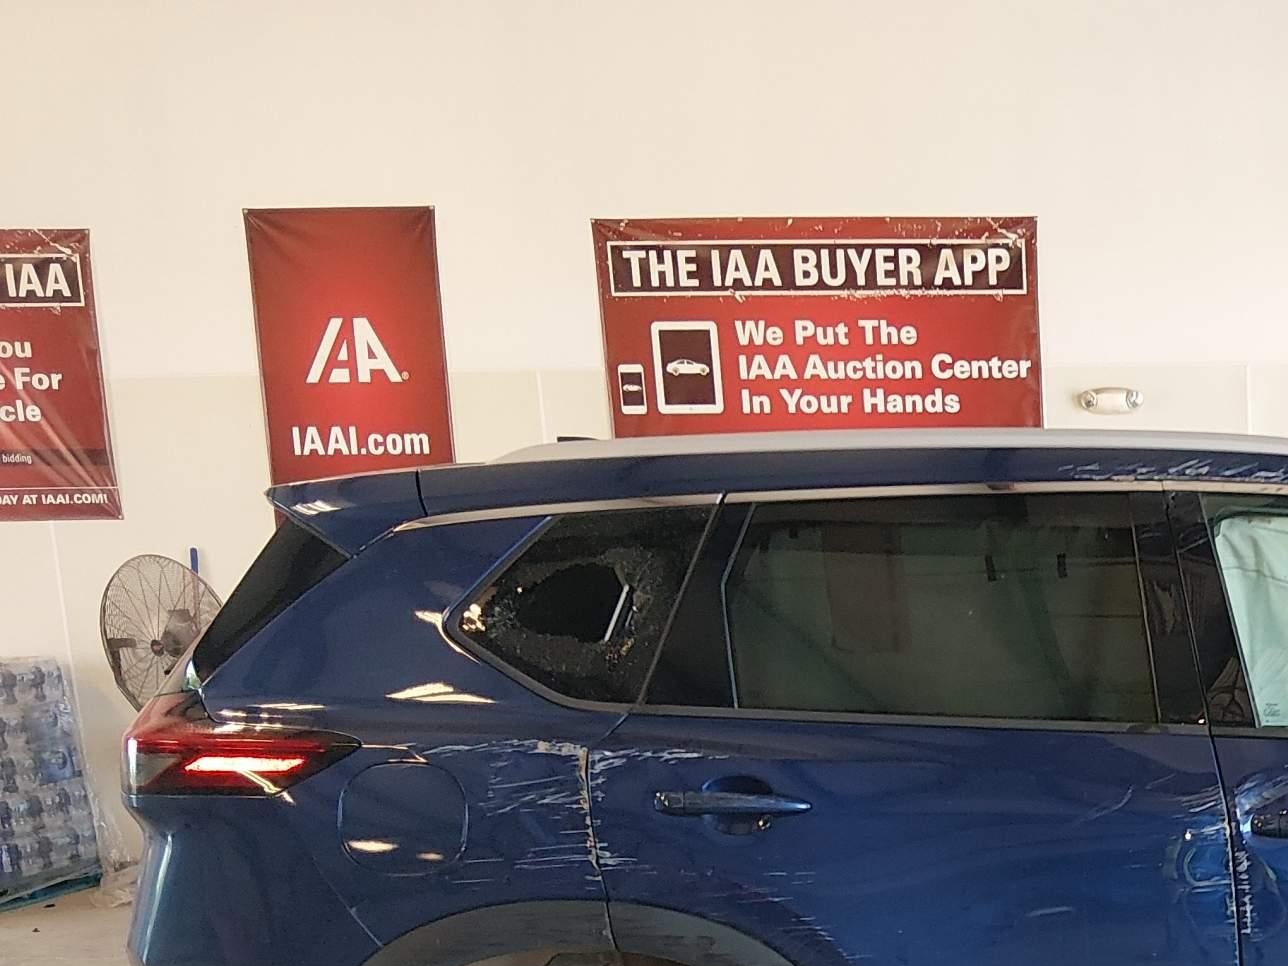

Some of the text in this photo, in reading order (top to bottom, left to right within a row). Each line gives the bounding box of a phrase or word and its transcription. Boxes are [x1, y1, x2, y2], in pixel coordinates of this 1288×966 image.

[623, 248, 1012, 287] THE IAA BUYER APP
[5, 263, 72, 297] IAA
[735, 320, 917, 345] We Put The
[0, 342, 32, 358] ou
[13, 367, 62, 390] For
[739, 354, 1031, 379] IAA Auction Center
[0, 400, 42, 422] cle
[742, 389, 960, 413] In Your Hands
[292, 426, 431, 456] IAAI.com
[2, 453, 32, 464] bidding
[22, 494, 38, 505] AT
